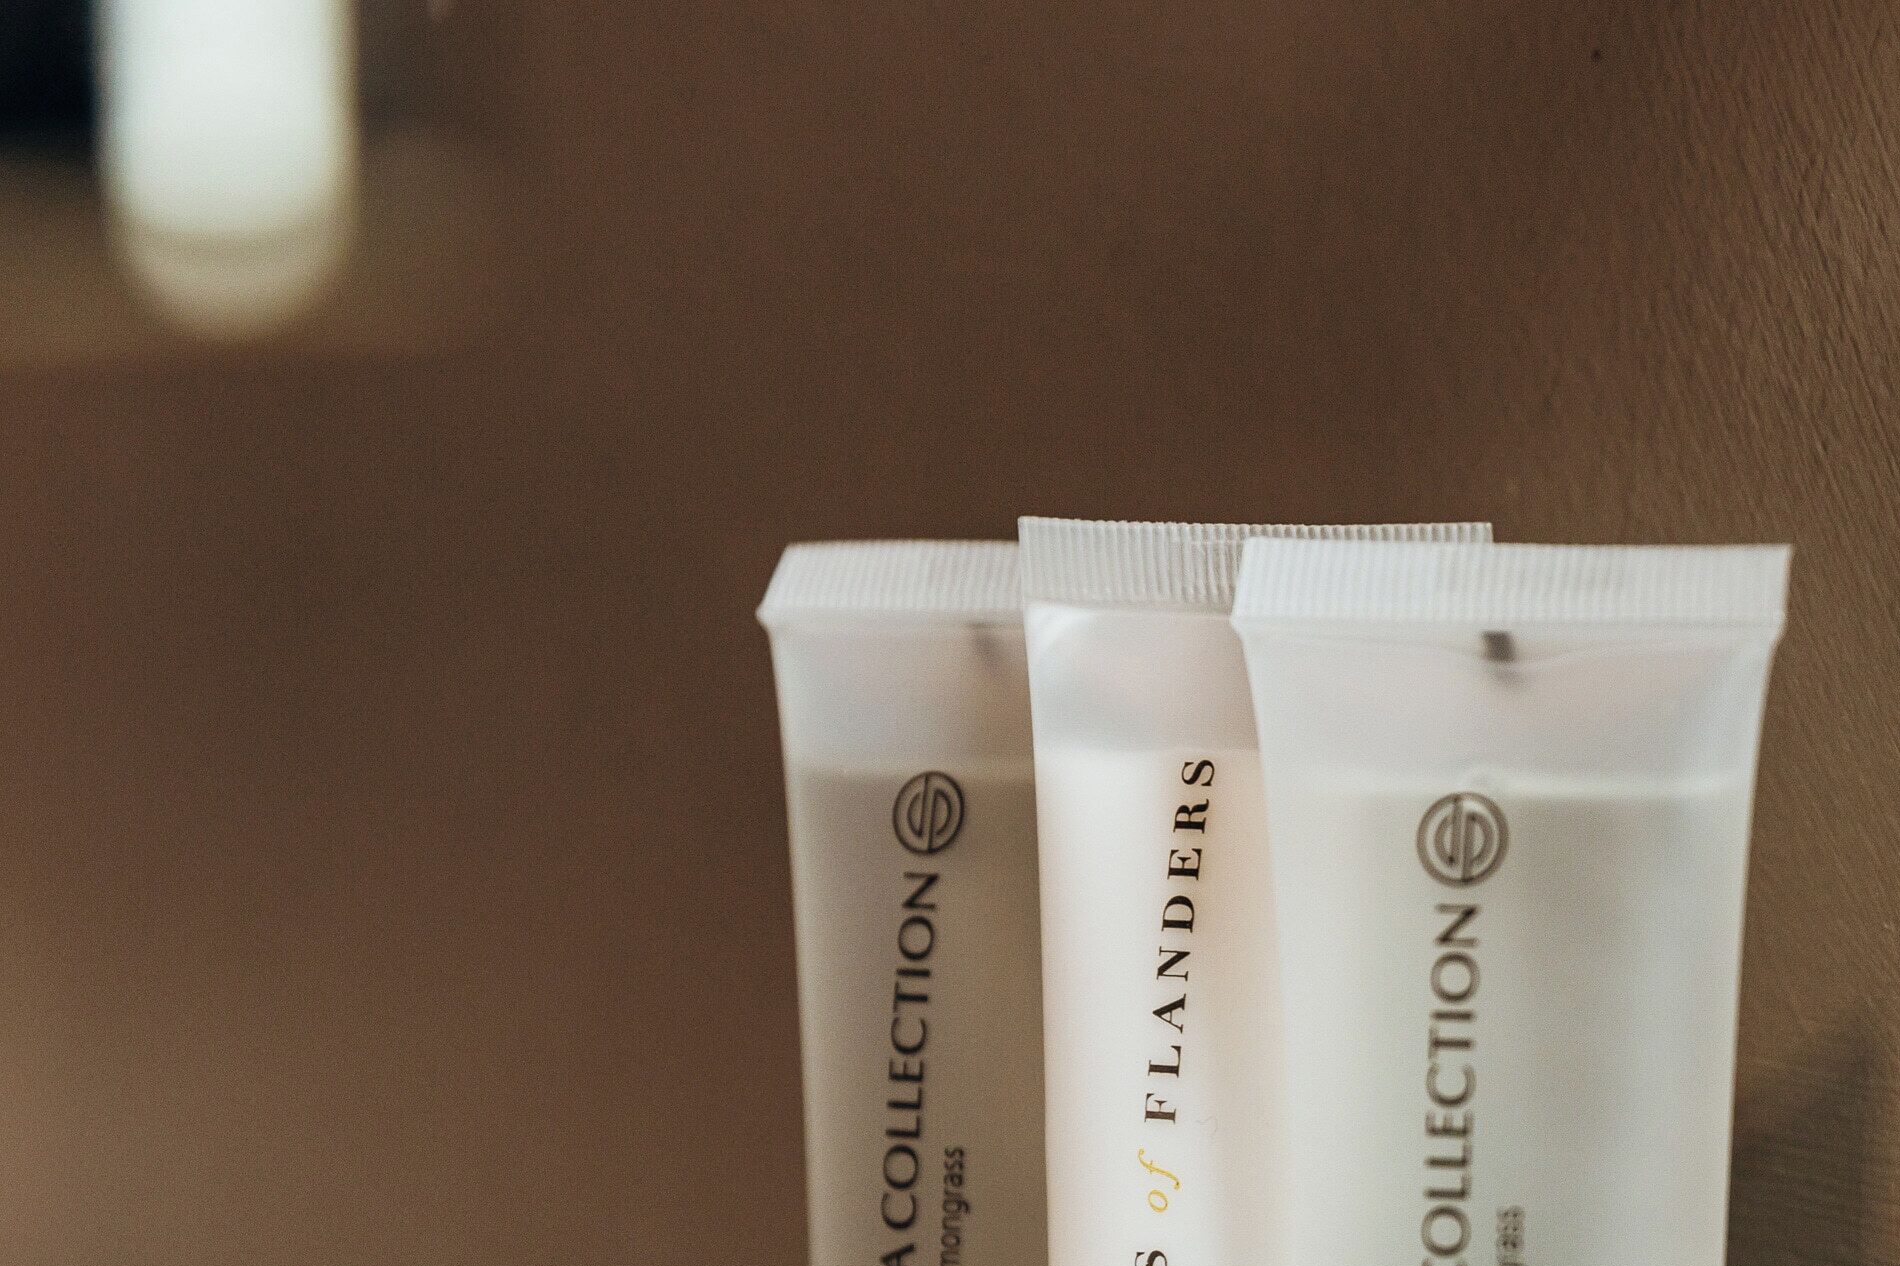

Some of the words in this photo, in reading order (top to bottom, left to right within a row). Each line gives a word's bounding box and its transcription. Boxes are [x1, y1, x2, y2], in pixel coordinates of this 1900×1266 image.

[880, 870, 940, 1230] COLLECTION
[1144, 758, 1216, 1125] FLANDERS
[1137, 1146, 1182, 1215] of
